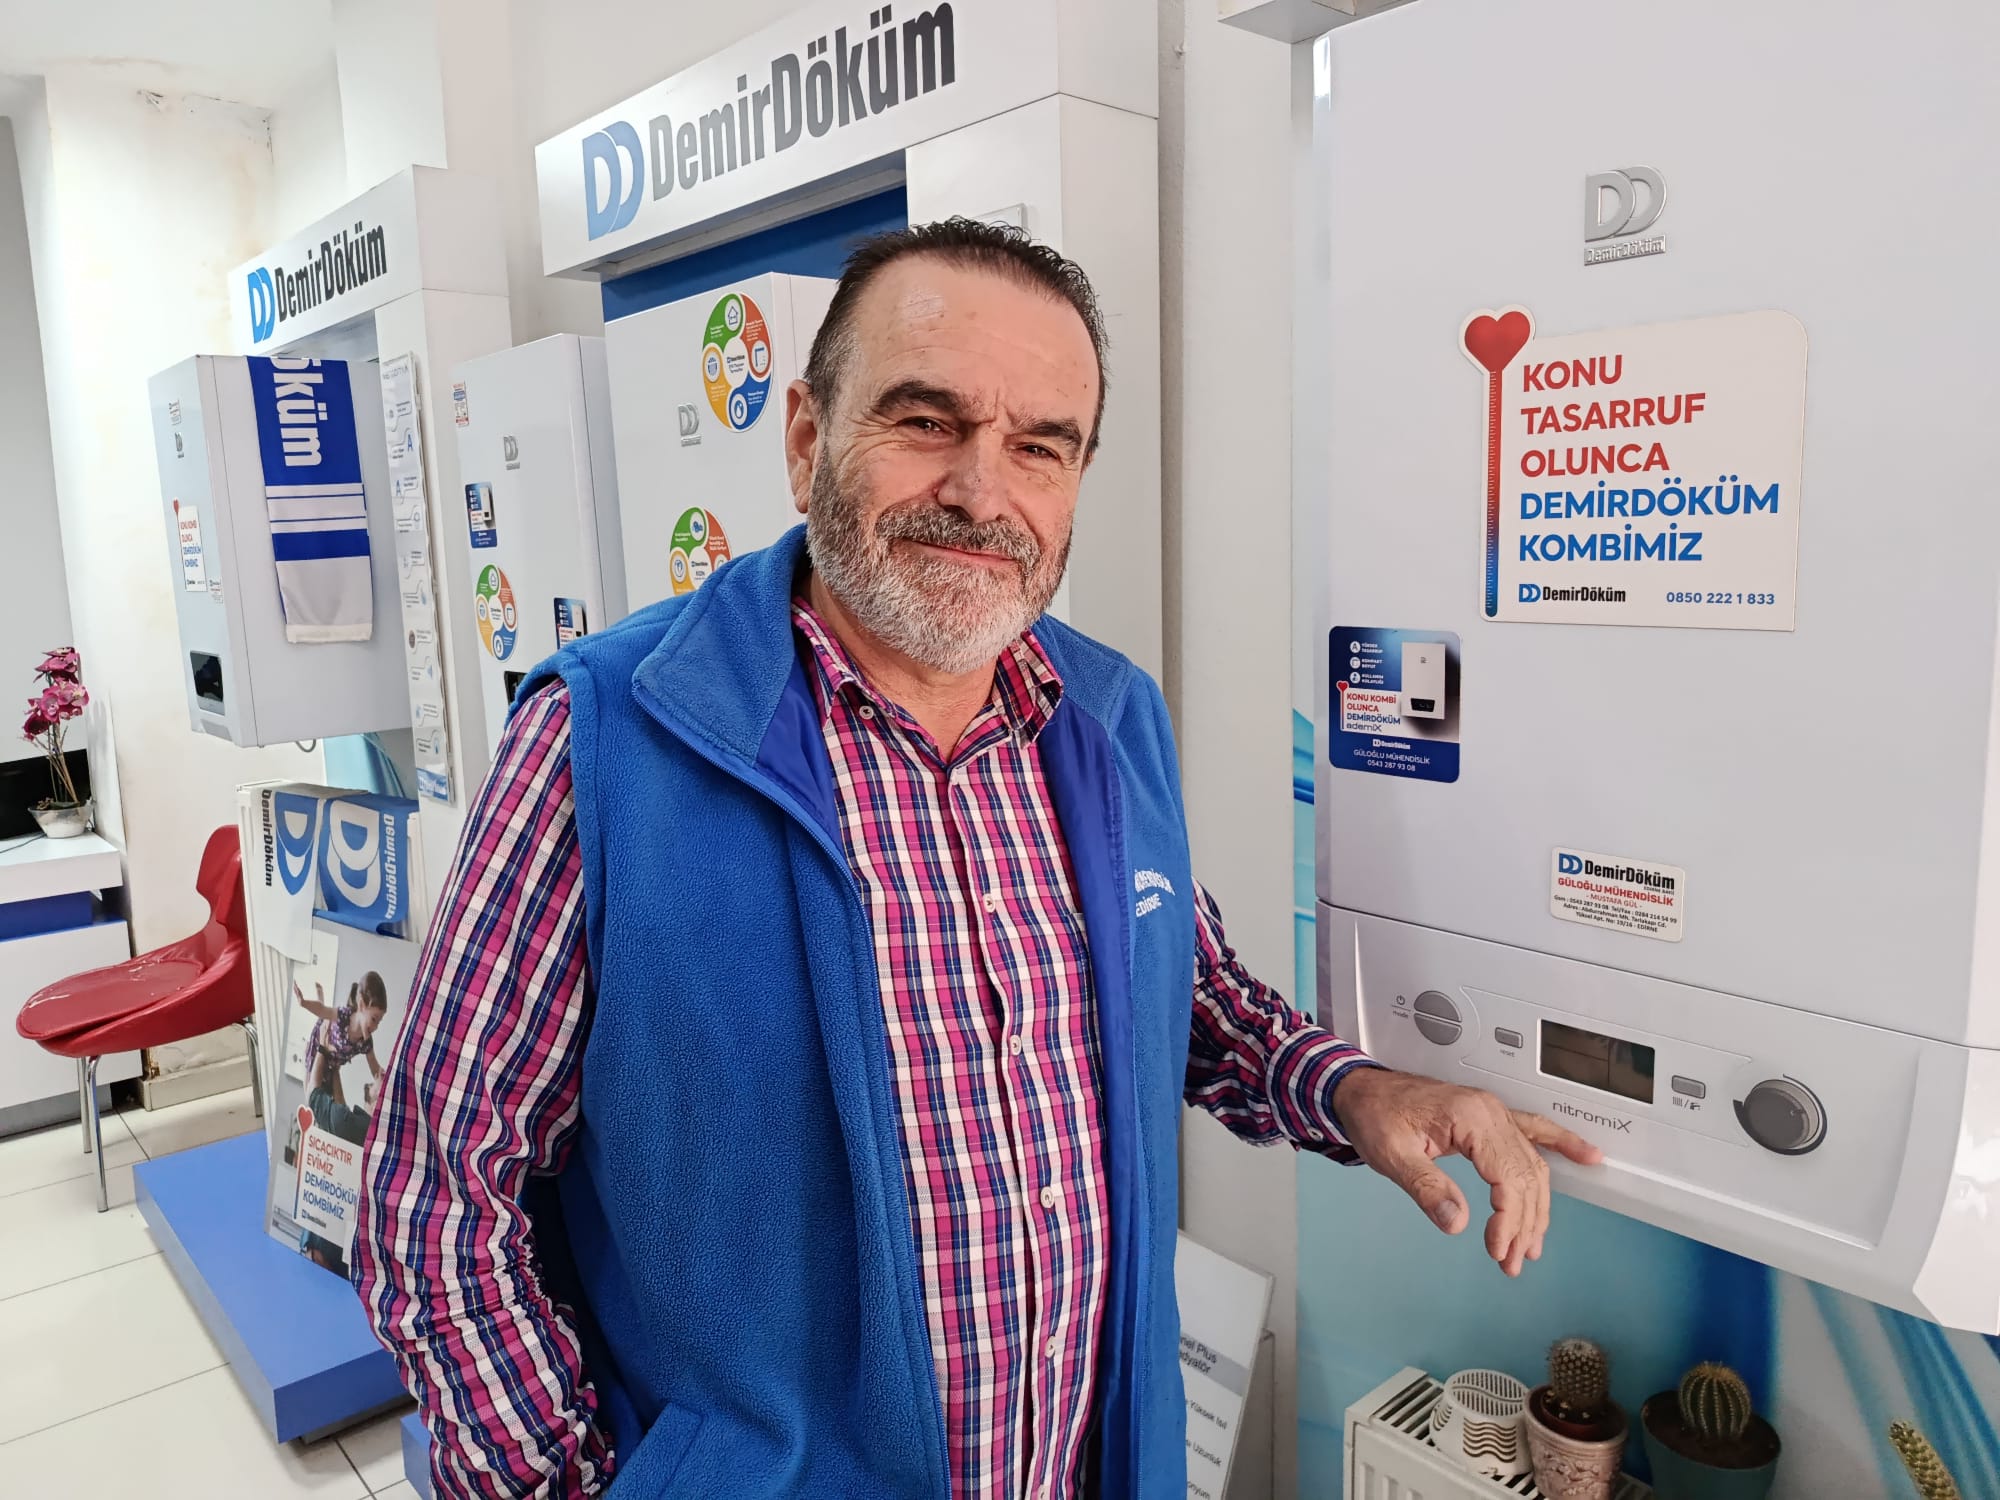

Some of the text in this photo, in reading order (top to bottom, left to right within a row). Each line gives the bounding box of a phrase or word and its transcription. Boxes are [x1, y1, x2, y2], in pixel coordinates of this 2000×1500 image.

[649, 2, 956, 201] DemirDöküm
[1586, 237, 1665, 263] DemirDöküm
[274, 220, 387, 322] DemirDöküm
[1523, 354, 1623, 393] KONU
[1521, 393, 1706, 435] TASARRUF
[1520, 442, 1670, 478] OLUNCA
[1520, 474, 1779, 520] DEMİRDÖKÜM
[1519, 522, 1703, 562] KOMBİMİZ
[1542, 586, 1626, 602] DemirDöküm
[1666, 591, 1702, 603] 0850
[1706, 592, 1733, 604] 222
[1747, 593, 1775, 605] 833
[1347, 692, 1397, 704] KONU KOMBİ
[1347, 703, 1379, 712] OLUNCA
[1346, 712, 1401, 725] DEMİRDÖKÜM
[1353, 749, 1430, 765] GÜLOĞLU MÜHENDİSLİK
[1367, 759, 1383, 768] 0543
[1384, 761, 1396, 769] 287
[262, 789, 273, 887] DemirDöküm
[383, 813, 397, 919] DemirDöküm
[1584, 859, 1675, 890] DemirDöküm
[1558, 876, 1674, 907] GÜLOĞLU MÜHENDİSLİK
[1590, 893, 1622, 906] MUSTAFA
[1623, 898, 1639, 909] GÜL
[307, 1153, 334, 1176] EVİMİZ
[308, 1135, 352, 1165] SICACIKTIR
[303, 1189, 345, 1221] KOMBİMİZ
[1196, 1342, 1218, 1364] Plus
